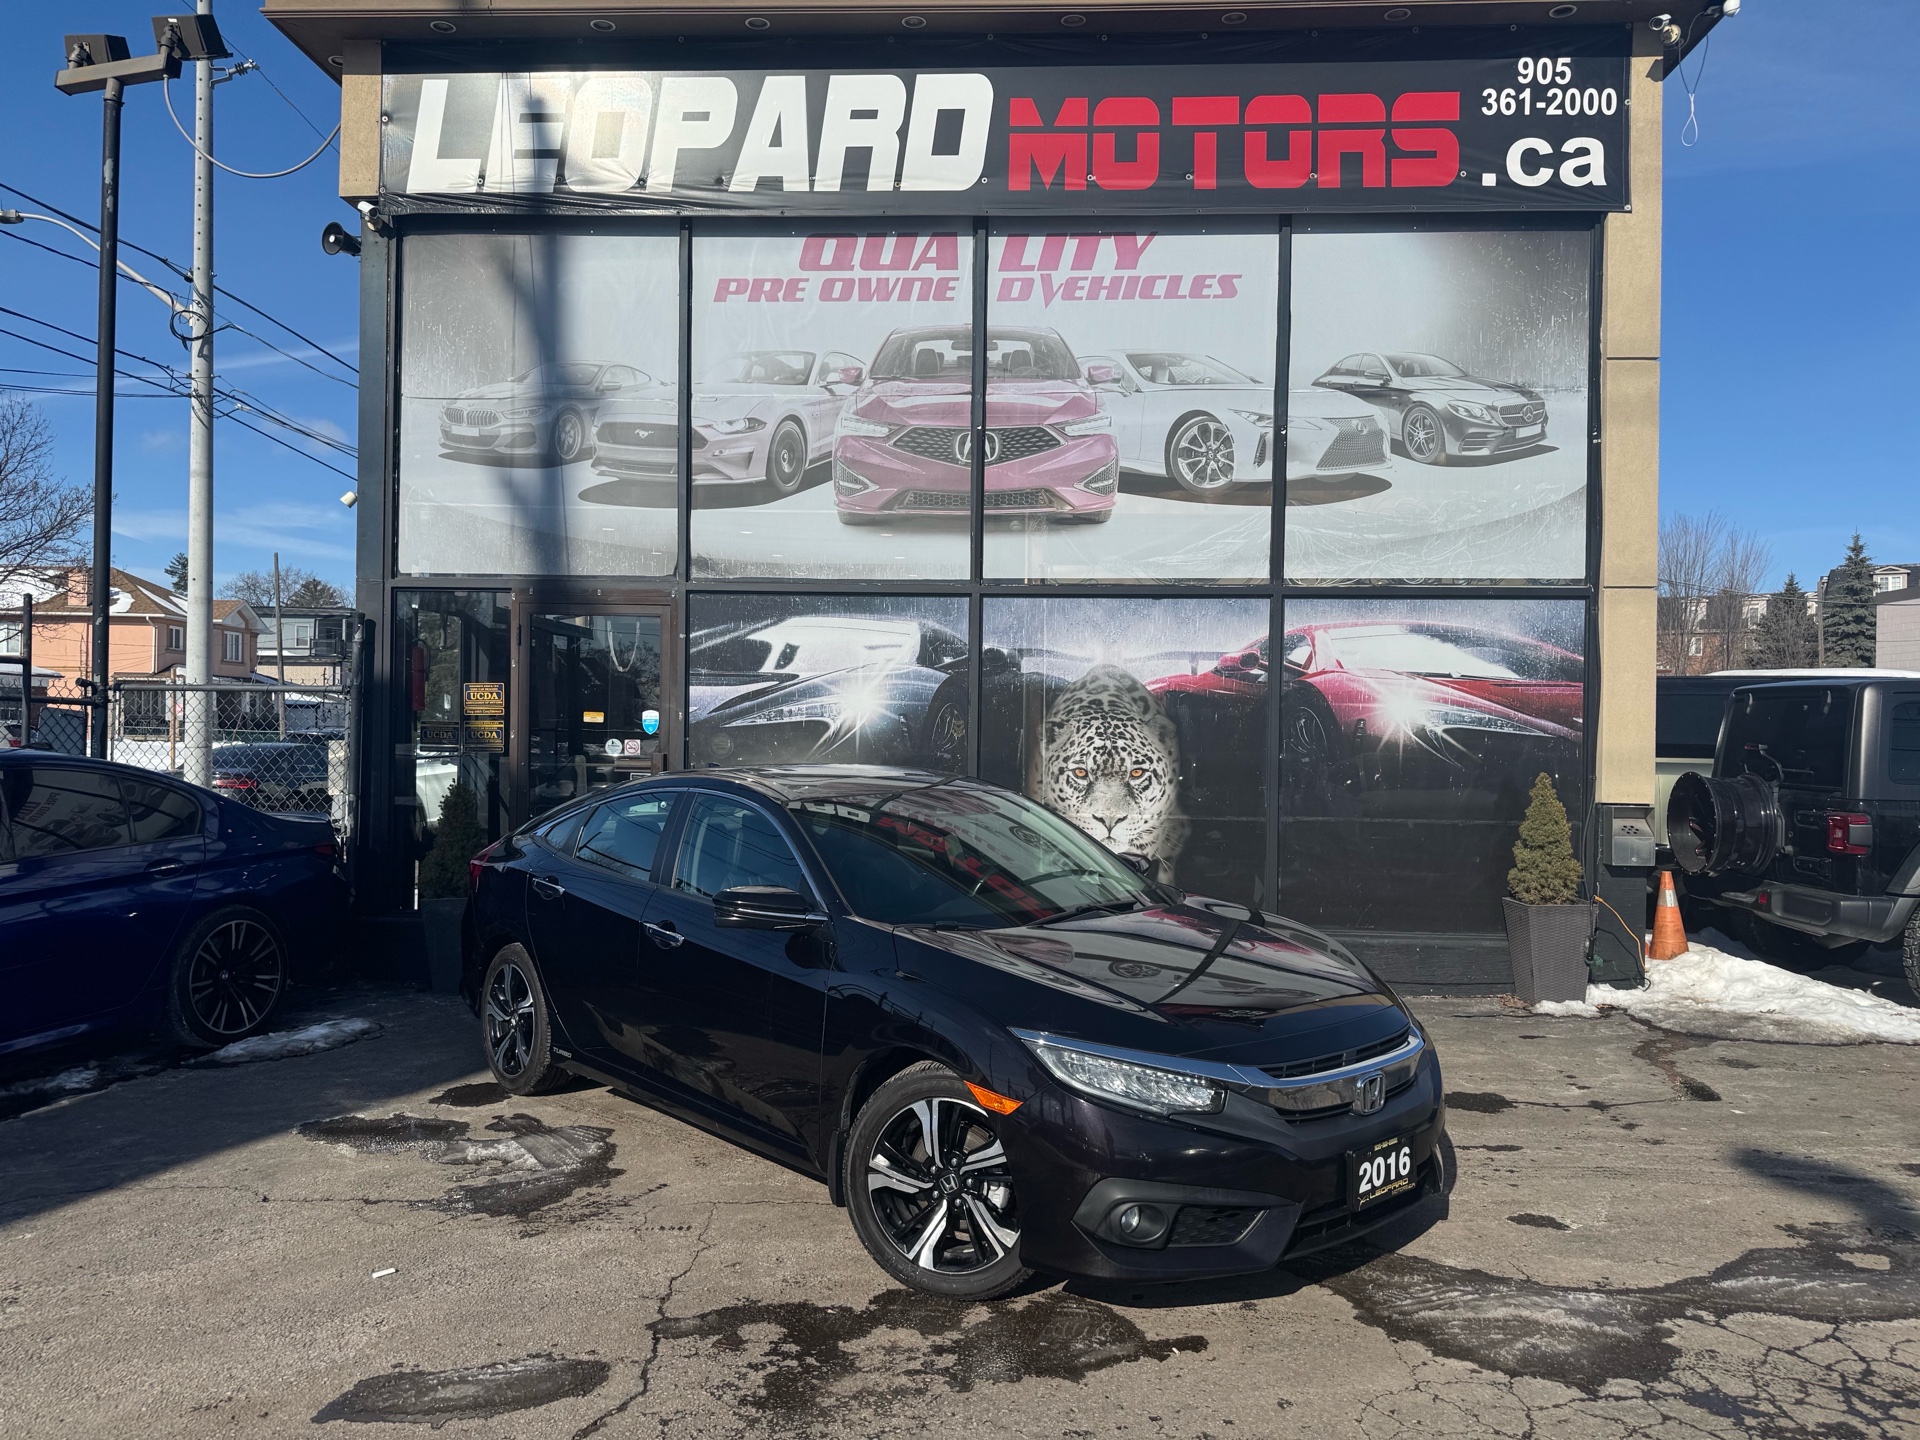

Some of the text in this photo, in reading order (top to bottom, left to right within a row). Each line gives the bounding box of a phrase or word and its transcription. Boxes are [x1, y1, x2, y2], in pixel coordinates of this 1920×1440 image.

[1517, 57, 1571, 85] 905
[1481, 87, 1618, 116] 361-2000
[406, 73, 1460, 194] LEOPARD MOTORS
[1481, 136, 1608, 187] .ca
[713, 278, 810, 302] PRE
[470, 692, 499, 700] UCDA
[426, 731, 454, 739] UCDA
[470, 731, 498, 739] UCDA
[1358, 1146, 1411, 1194] 2016
